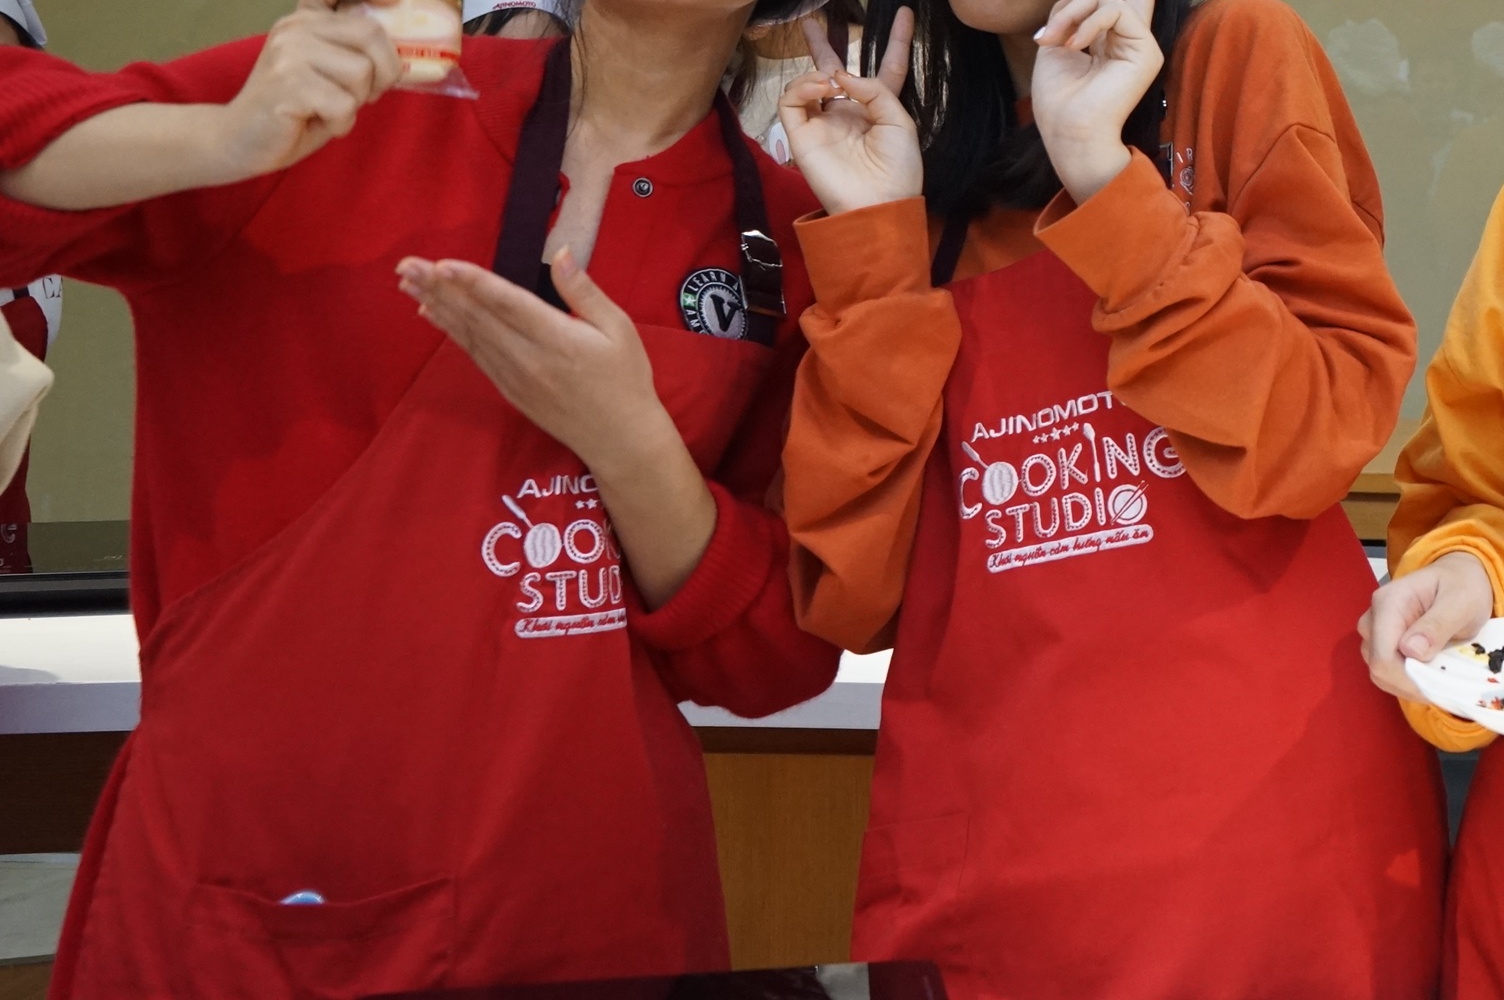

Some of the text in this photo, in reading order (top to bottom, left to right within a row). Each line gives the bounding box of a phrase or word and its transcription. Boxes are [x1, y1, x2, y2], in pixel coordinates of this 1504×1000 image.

[971, 391, 1118, 442] AJINOMOT
[517, 475, 599, 498] AJINO
[959, 423, 1187, 519] COOKING
[985, 481, 1148, 549] STUDIO
[481, 519, 622, 577] COOK
[516, 565, 622, 613] STUD
